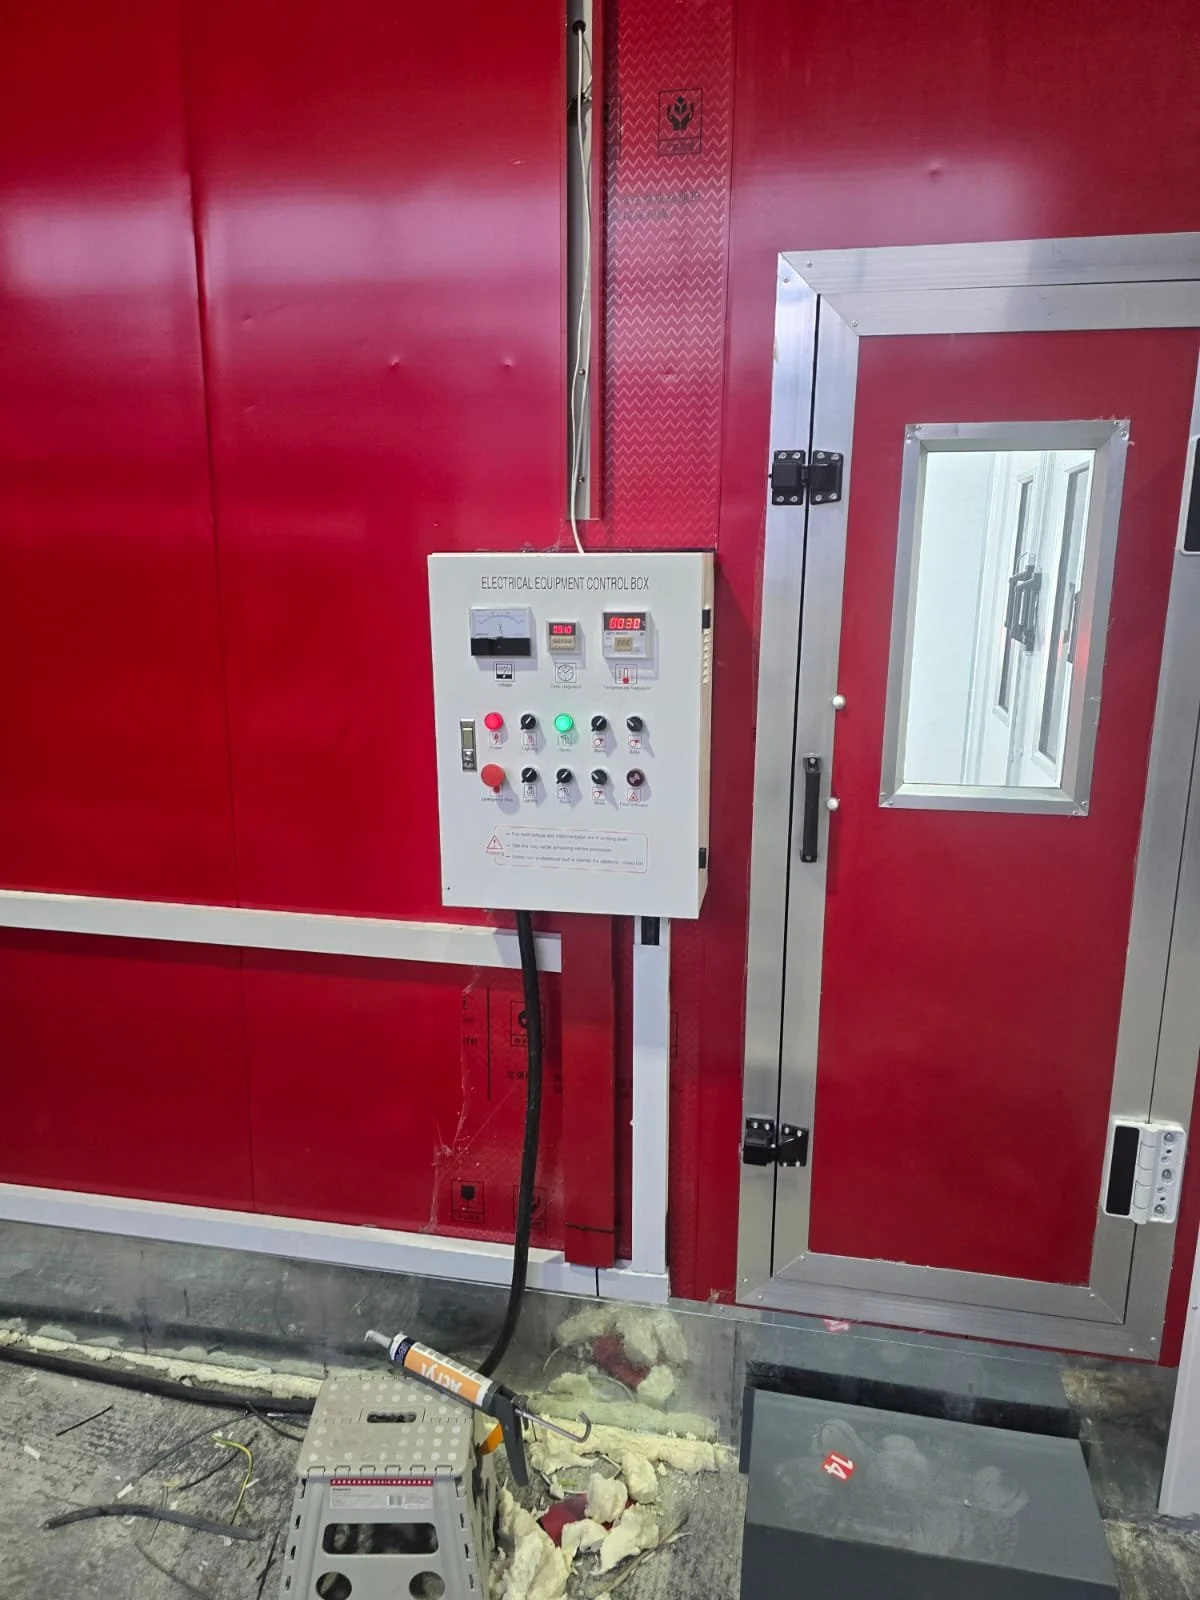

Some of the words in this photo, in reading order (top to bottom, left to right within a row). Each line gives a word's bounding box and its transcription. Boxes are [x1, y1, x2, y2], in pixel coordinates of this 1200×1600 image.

[481, 576, 532, 590] ELECTRICAL
[534, 576, 584, 590] EQUIPMENT
[586, 577, 628, 590] CONTROL
[630, 576, 649, 590] BOX
[824, 1454, 853, 1480] 14
